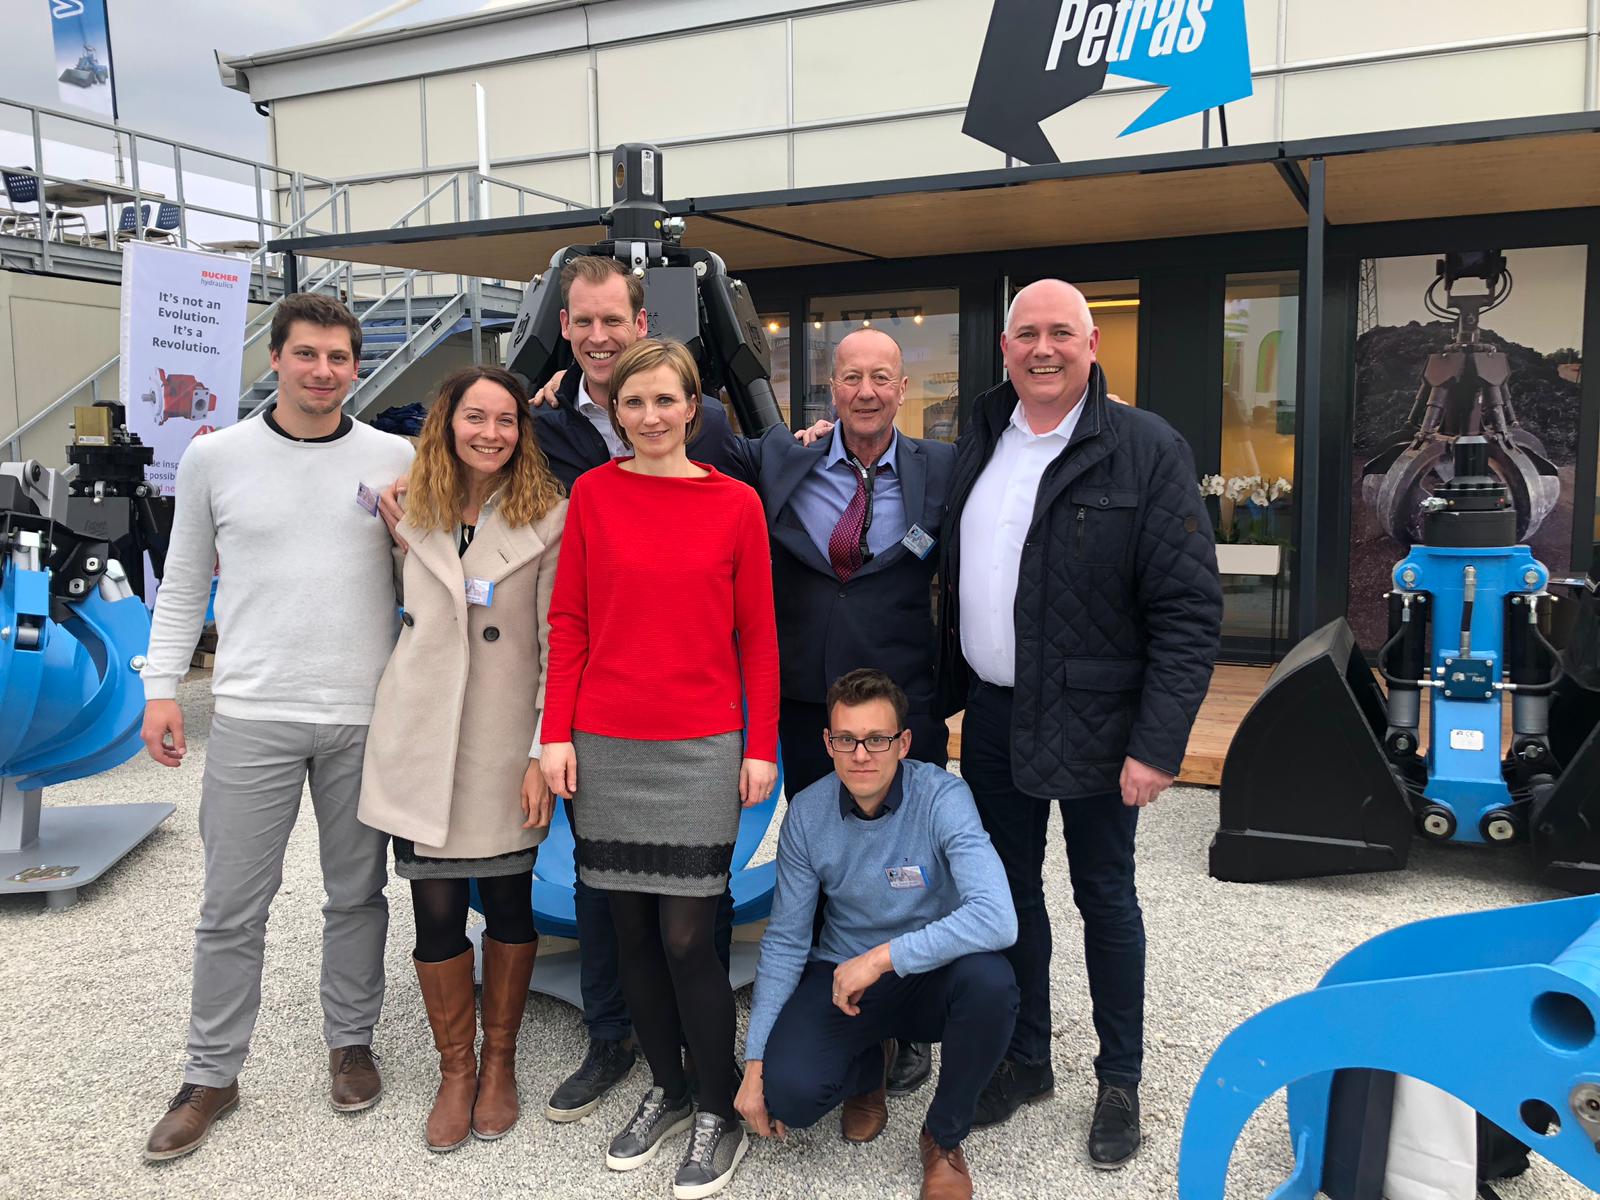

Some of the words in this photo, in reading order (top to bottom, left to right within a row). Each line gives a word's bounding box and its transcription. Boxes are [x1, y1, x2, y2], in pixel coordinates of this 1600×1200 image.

[1045, 0, 1212, 71] Petras
[200, 278, 234, 289] hydraulics
[201, 270, 238, 282] BUCHER
[159, 292, 179, 304] It's
[182, 295, 203, 308] not
[206, 301, 221, 310] an
[158, 307, 220, 325] Evolution.
[173, 325, 193, 336] It's
[196, 329, 203, 338] a
[152, 337, 220, 355] Revolution.
[149, 472, 176, 481] possib
